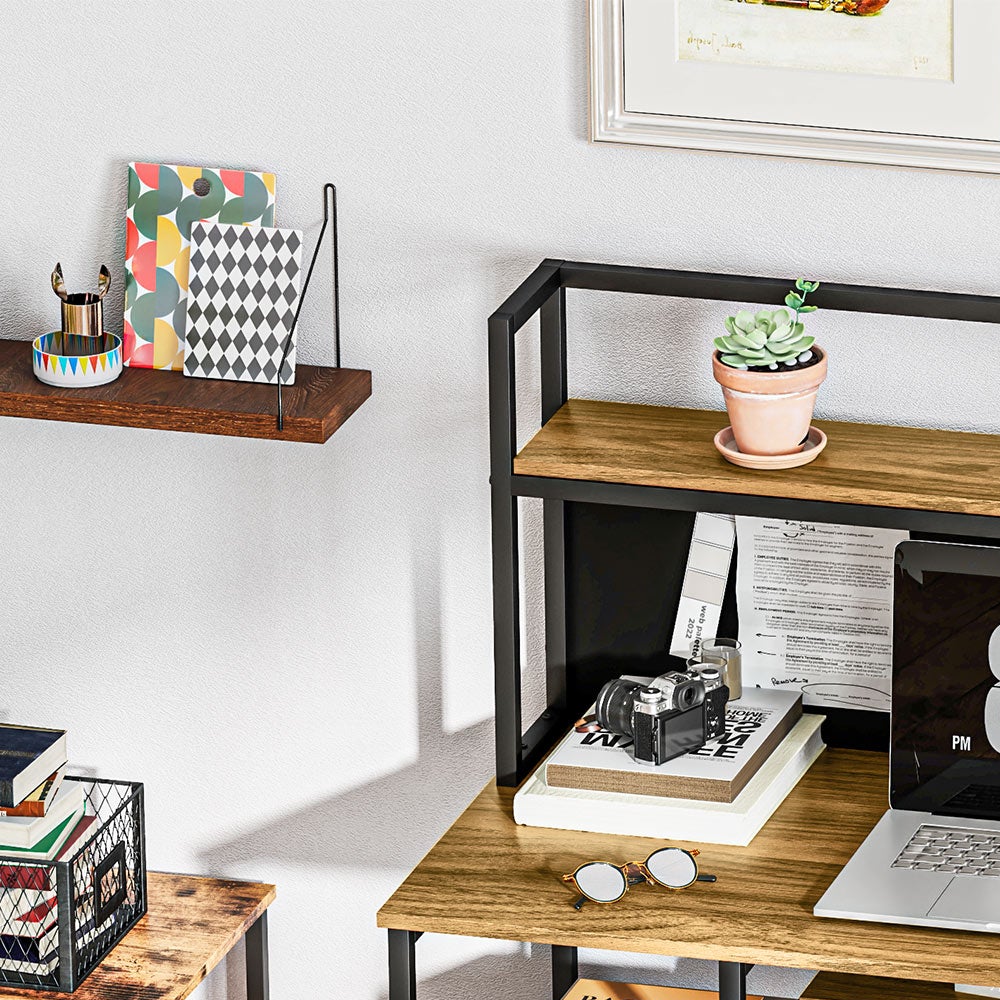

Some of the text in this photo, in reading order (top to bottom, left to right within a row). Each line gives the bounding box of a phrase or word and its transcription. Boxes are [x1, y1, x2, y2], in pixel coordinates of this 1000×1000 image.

[685, 618, 695, 639] 2022
[691, 605, 707, 658] web palette
[952, 735, 971, 751] PM
